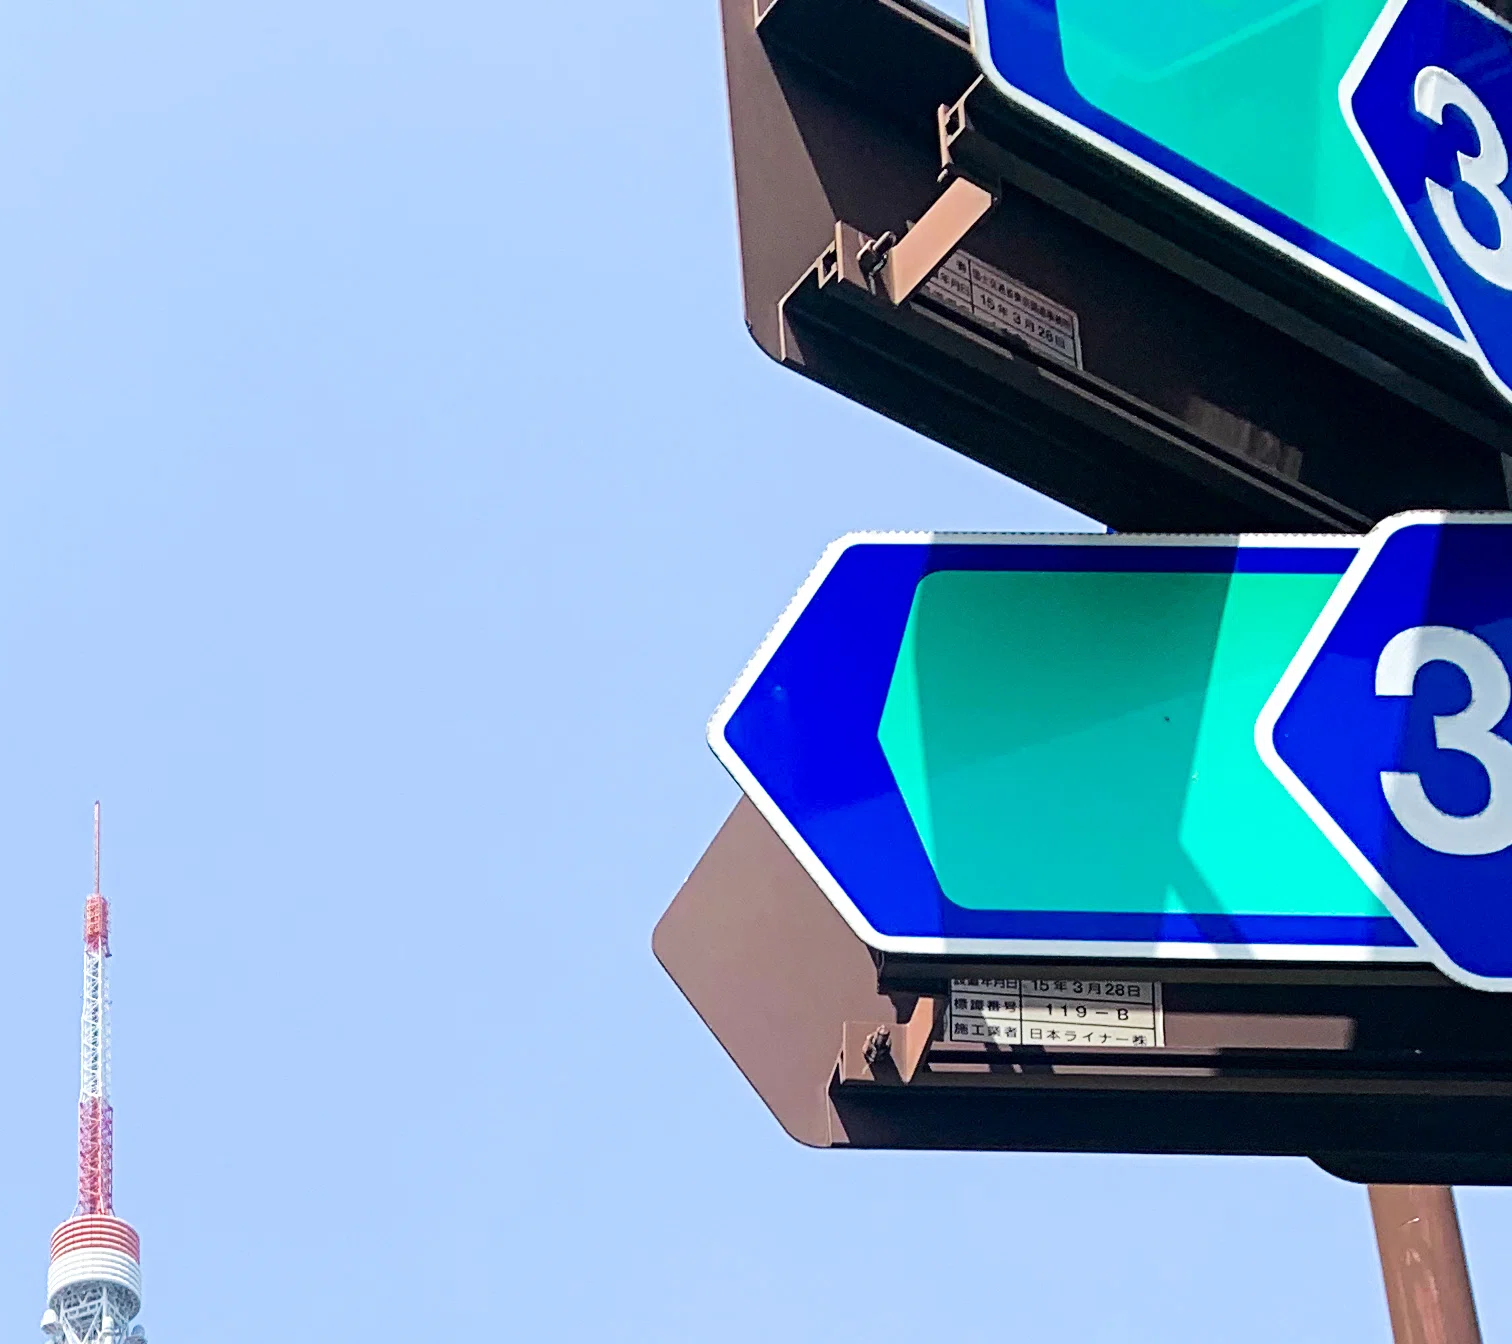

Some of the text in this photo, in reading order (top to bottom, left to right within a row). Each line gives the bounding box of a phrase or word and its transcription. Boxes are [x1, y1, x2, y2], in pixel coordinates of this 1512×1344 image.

[1414, 65, 1512, 291] 3
[1375, 625, 1512, 856] 3
[1031, 980, 1141, 998] 15年3月28日
